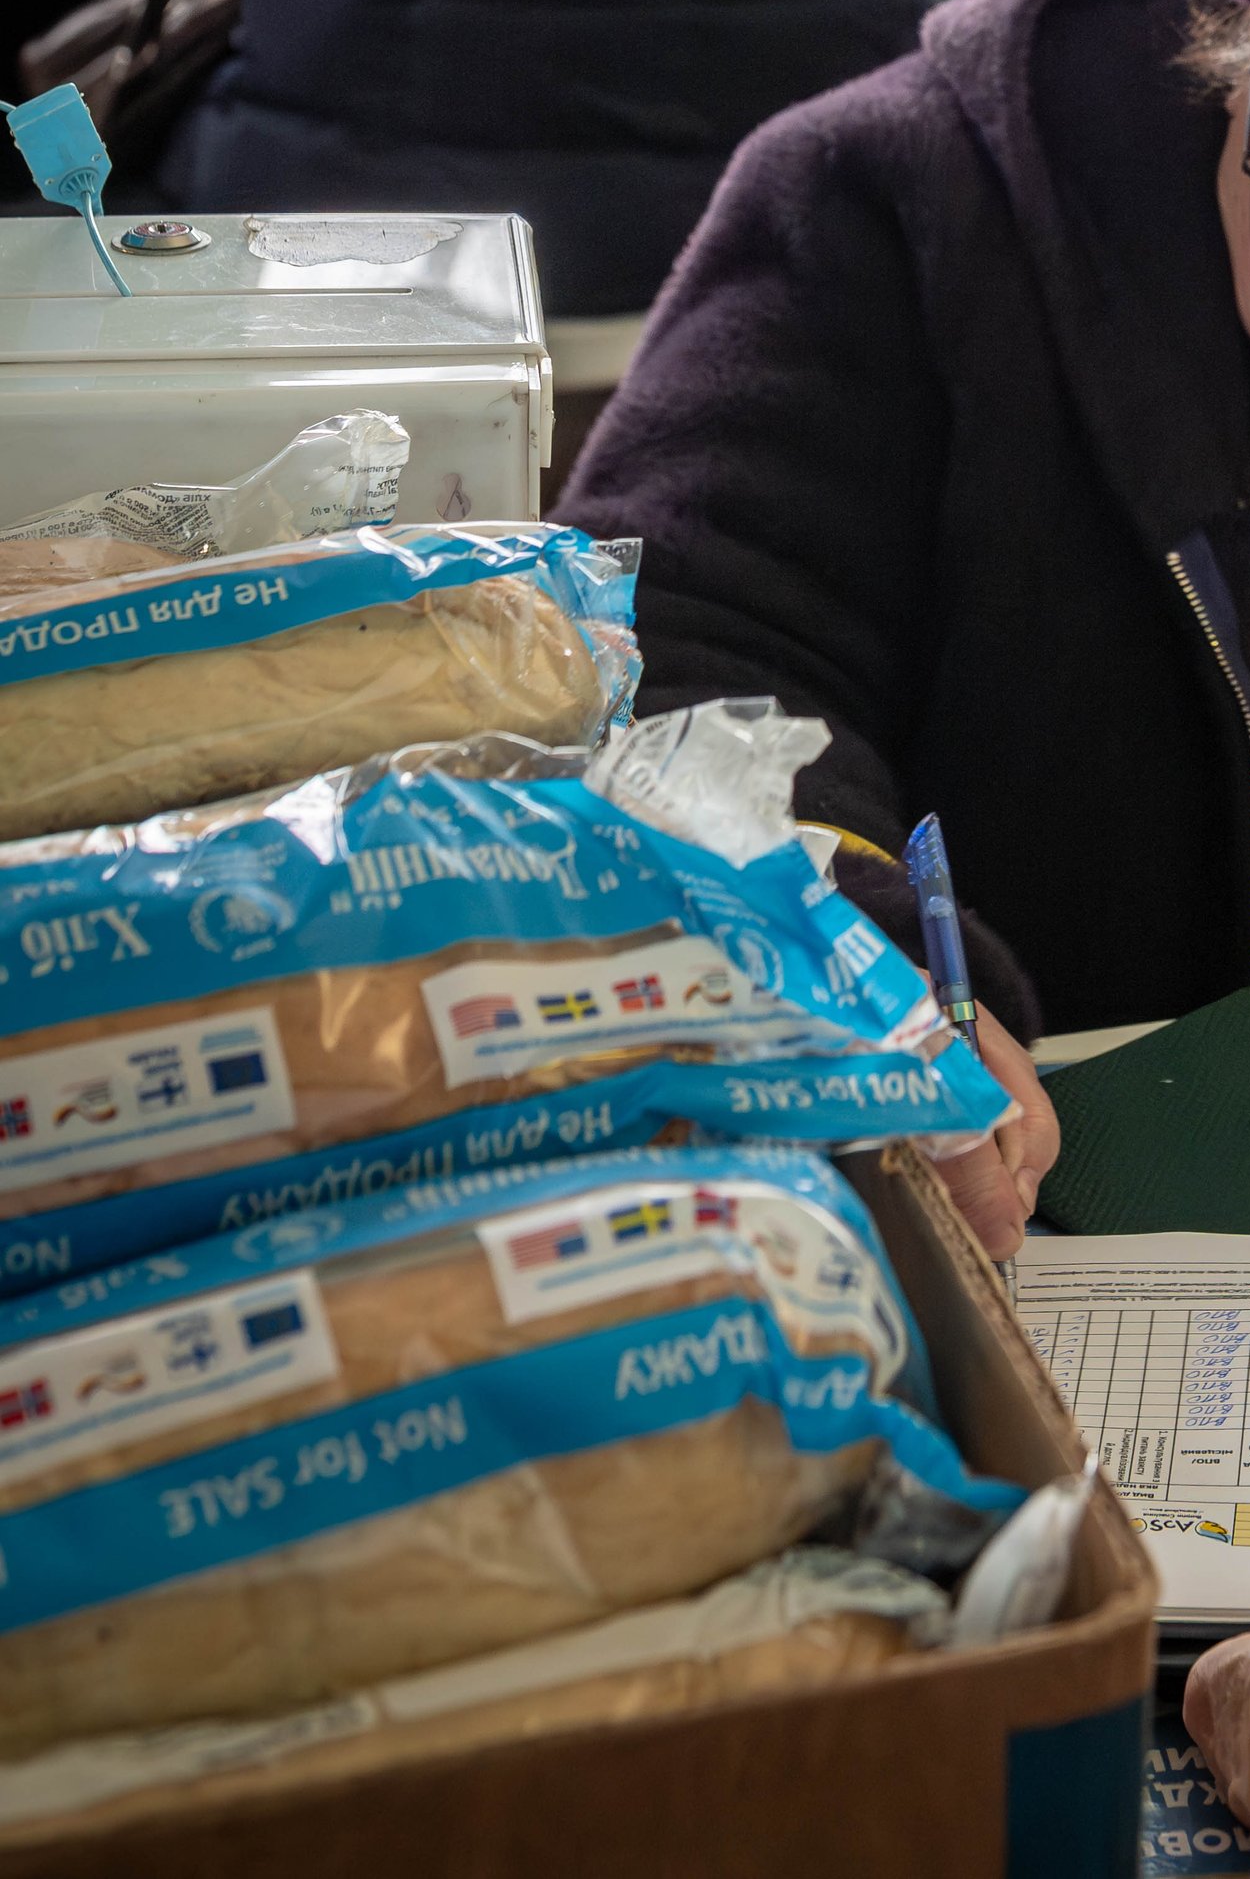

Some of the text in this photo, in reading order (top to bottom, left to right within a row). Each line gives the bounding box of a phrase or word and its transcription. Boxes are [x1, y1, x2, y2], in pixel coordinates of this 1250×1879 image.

[146, 586, 224, 626] для
[235, 575, 290, 608] Не
[20, 901, 151, 979] Хліб
[722, 1075, 813, 1114] SALE
[463, 1112, 549, 1163] для
[554, 1101, 614, 1140] Не
[371, 1396, 469, 1467] Not
[292, 1430, 368, 1486] for
[157, 1456, 287, 1540] SALE
[1132, 1491, 1155, 1499] Вид
